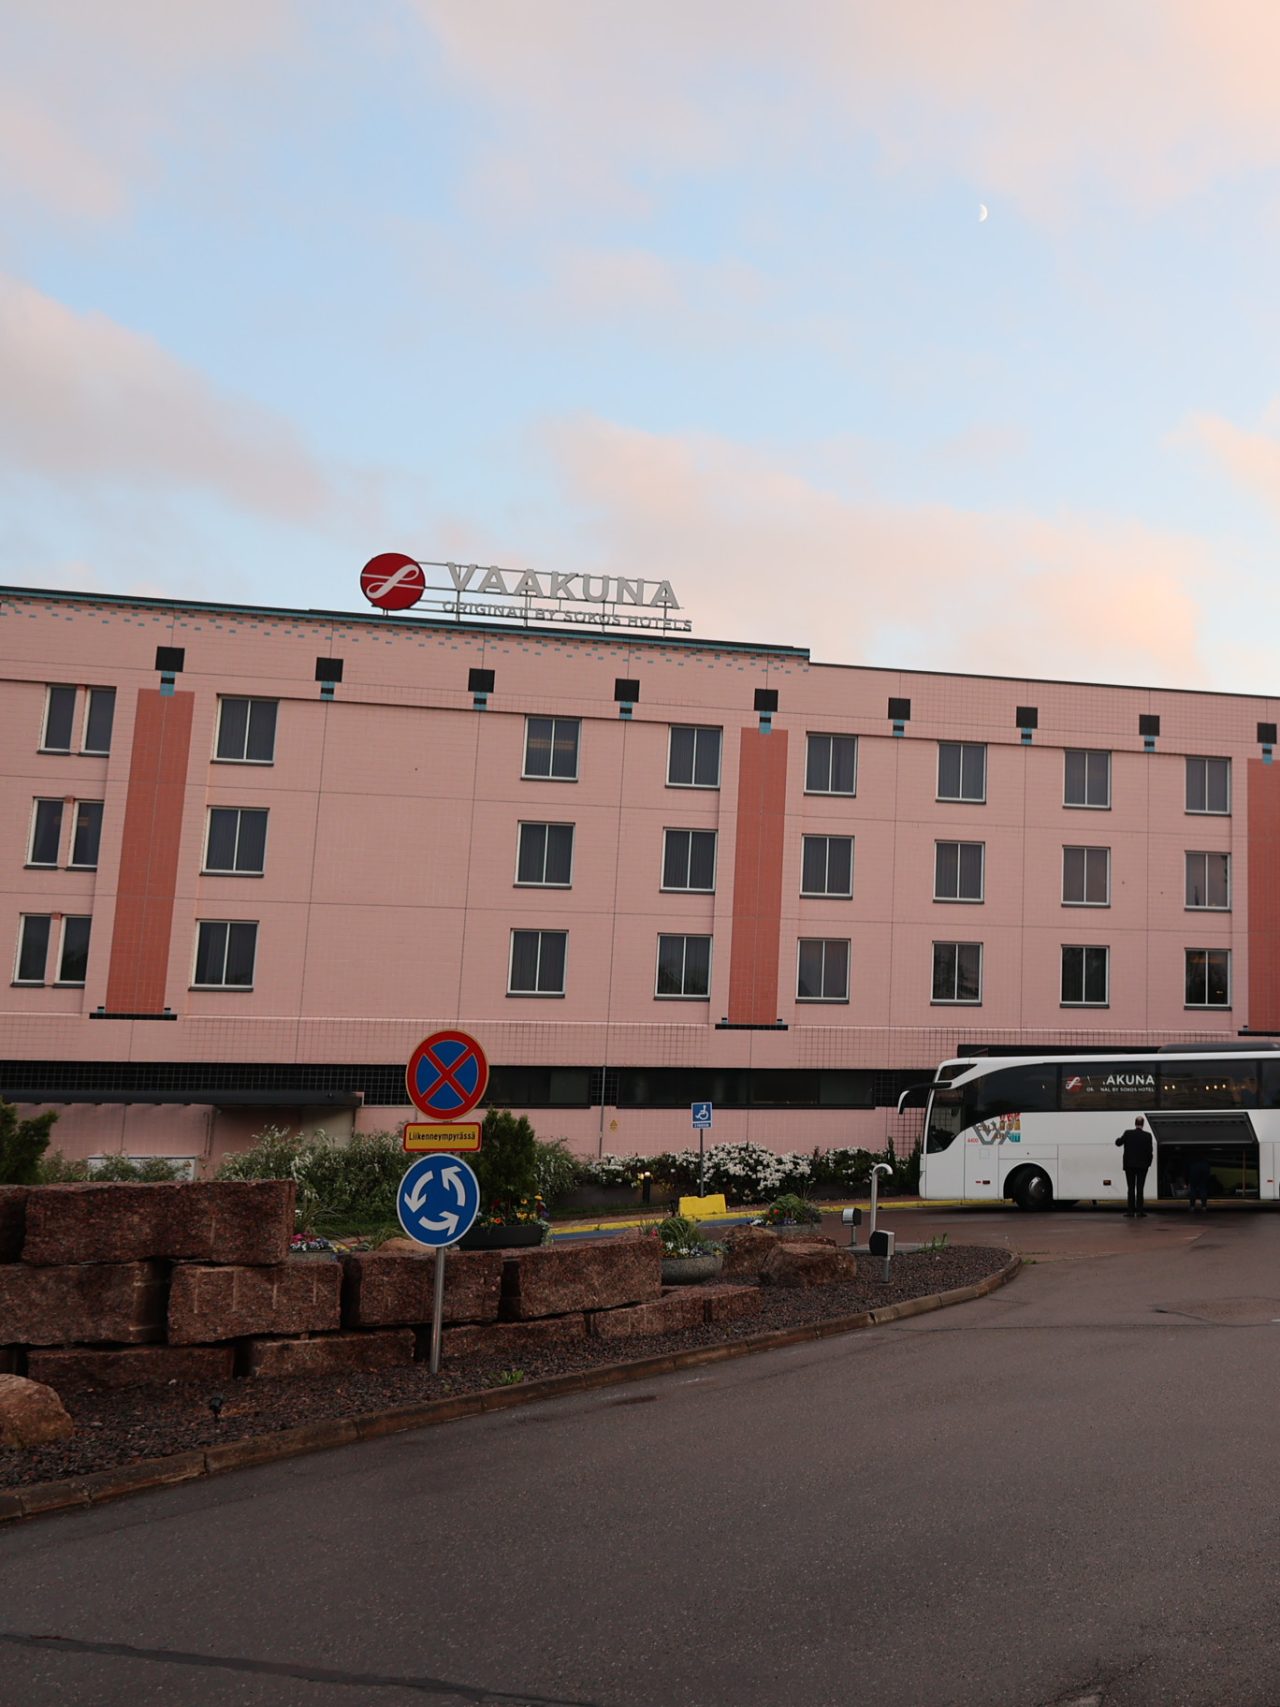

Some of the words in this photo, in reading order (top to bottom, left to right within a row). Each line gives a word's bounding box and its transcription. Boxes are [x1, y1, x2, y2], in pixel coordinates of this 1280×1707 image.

[446, 562, 681, 609] VAAKUNA
[442, 601, 527, 618] ORIGINAL
[535, 607, 556, 621] BY
[563, 610, 621, 625] SOKOS
[628, 615, 692, 632] HOTELS
[1087, 1075, 1155, 1085] AKUNA
[409, 1131, 475, 1142] Liikenneympyrässä
